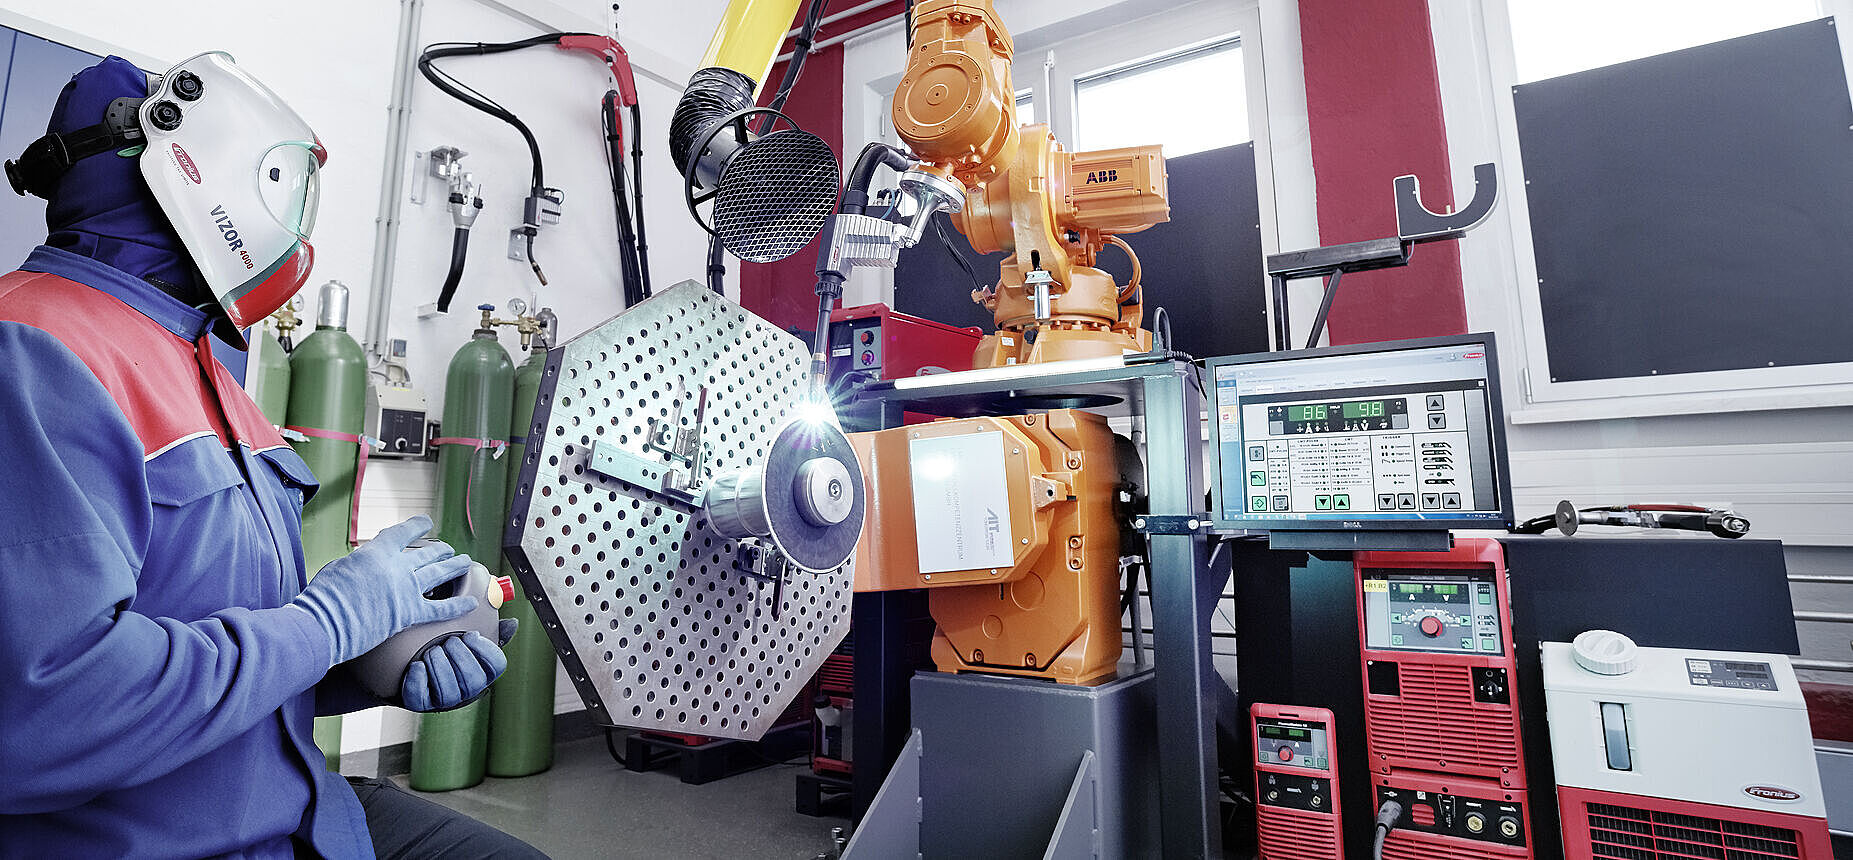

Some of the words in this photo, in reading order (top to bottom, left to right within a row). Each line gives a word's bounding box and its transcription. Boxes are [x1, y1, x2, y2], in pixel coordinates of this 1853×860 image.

[1086, 169, 1118, 184] ABB
[210, 204, 244, 252] VIZOR
[240, 249, 254, 270] 4000
[1303, 405, 1326, 420] 86
[986, 507, 1000, 533] AIT
[1749, 786, 1797, 799] Fronius
